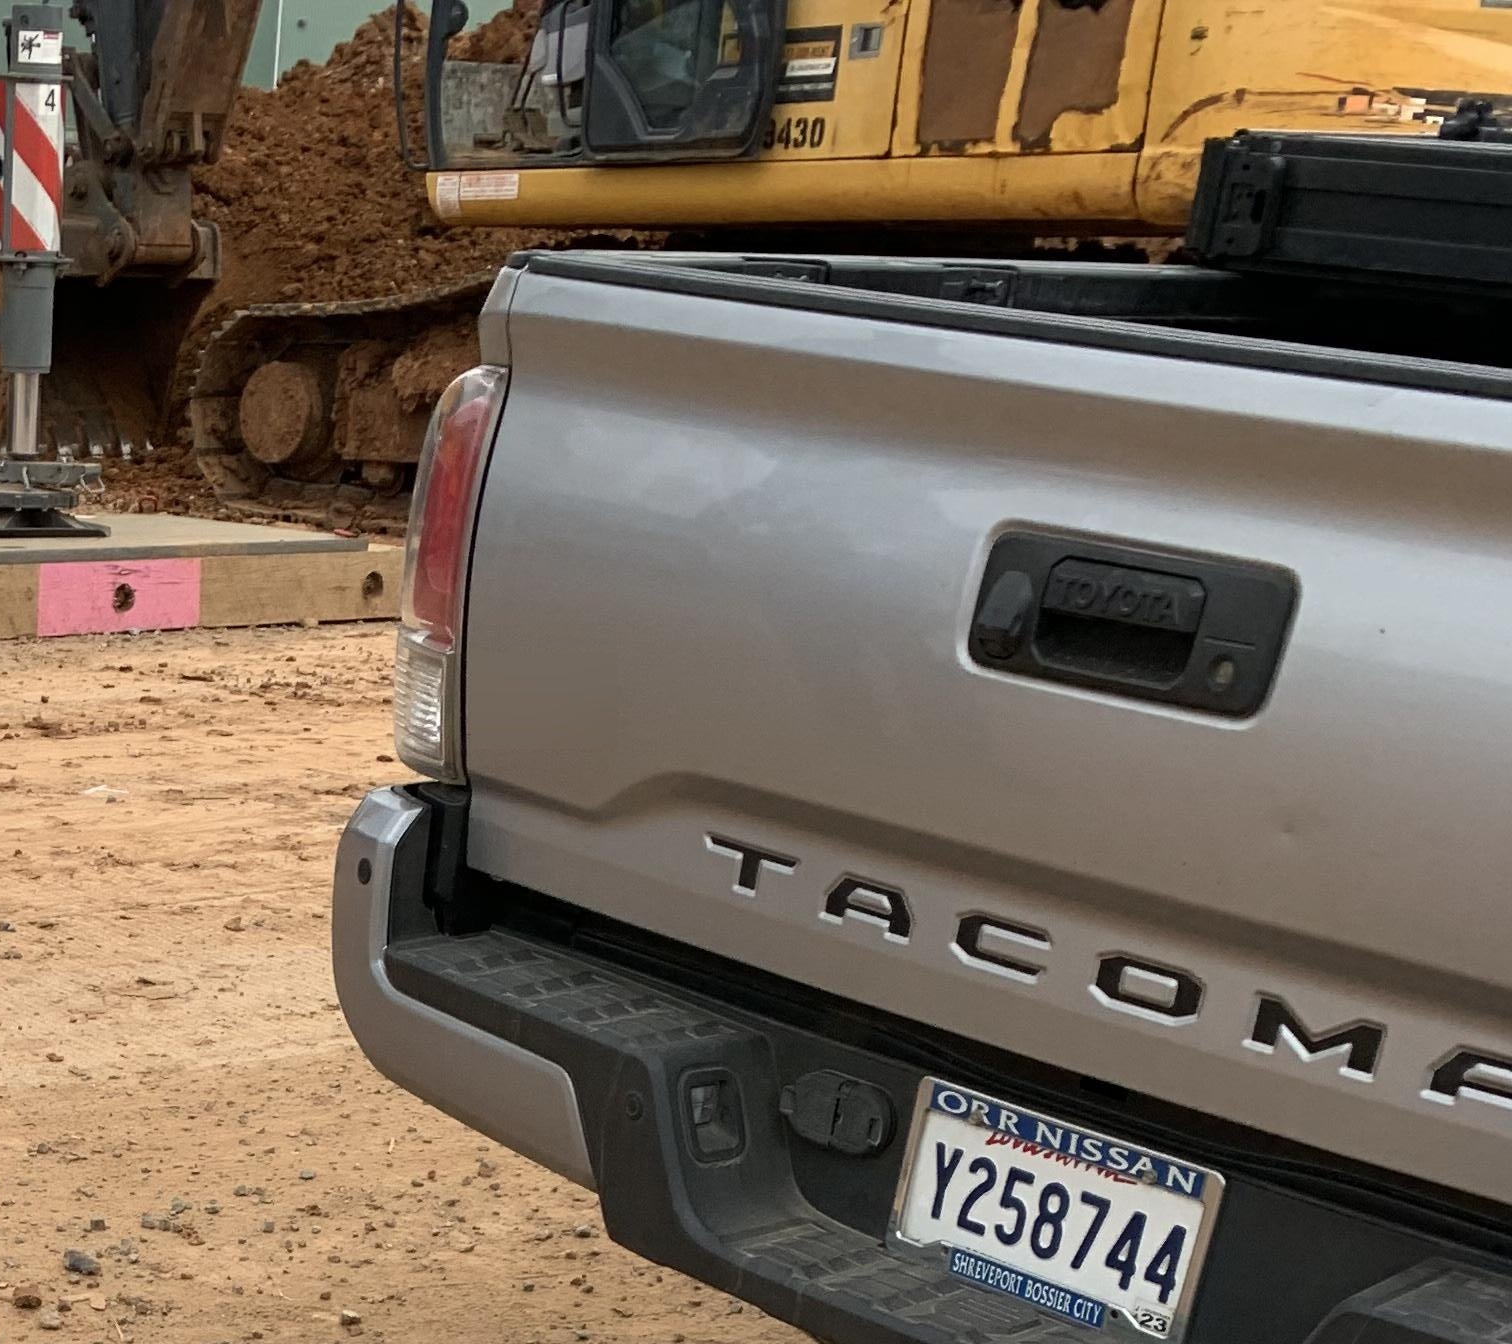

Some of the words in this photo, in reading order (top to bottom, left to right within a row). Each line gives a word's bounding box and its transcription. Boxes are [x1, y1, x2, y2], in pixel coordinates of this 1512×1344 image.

[44, 89, 56, 111] 4
[1054, 576, 1180, 628] TOYOTA
[704, 832, 1512, 1106] TACOMA
[937, 1089, 1021, 1136] ORR
[1034, 1120, 1197, 1194] NISSAN
[931, 1141, 1187, 1305] Y258744
[952, 1252, 1023, 1295] SHREVEPORT
[1025, 1278, 1071, 1314] BOSSIER
[1073, 1297, 1104, 1325] CITY
[1139, 1312, 1168, 1333] 23
